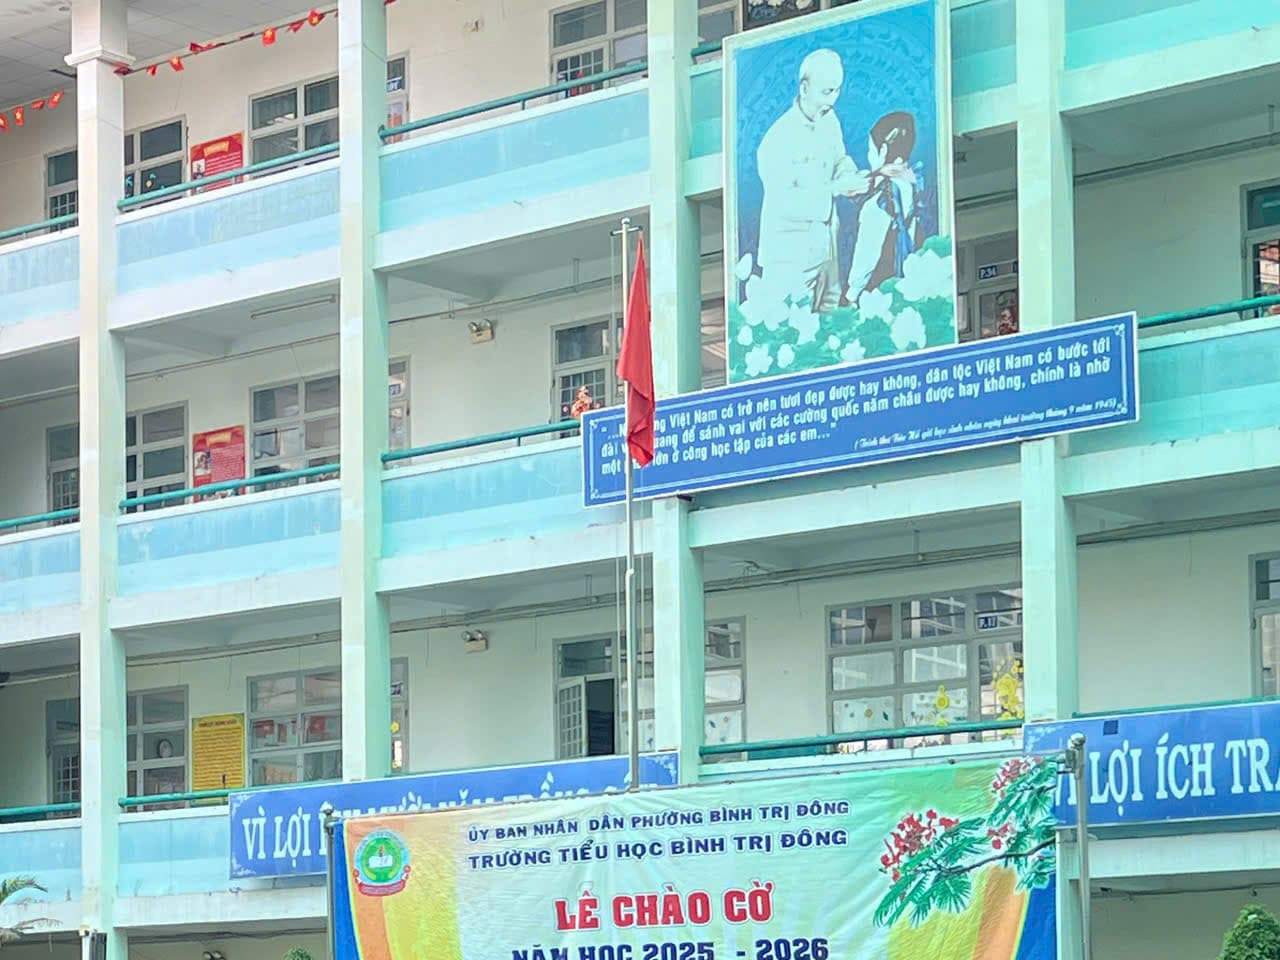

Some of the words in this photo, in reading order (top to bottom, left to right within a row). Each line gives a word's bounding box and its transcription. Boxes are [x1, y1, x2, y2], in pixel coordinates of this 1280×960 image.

[694, 409, 717, 425] Nam
[860, 381, 879, 396] hay
[1005, 353, 1033, 371] Nam
[959, 382, 980, 398] hay
[1089, 739, 1143, 816] LỢI
[1155, 732, 1215, 800] ÍCH
[1225, 738, 1280, 794] TR
[242, 805, 266, 860] VÌ
[273, 806, 311, 868] LỢI
[468, 826, 489, 841] ỦY
[495, 825, 527, 839] BAN
[533, 819, 578, 836] NHÂN
[589, 815, 624, 831] DÂN
[631, 810, 703, 828] PHƯỜNG
[710, 807, 752, 822] BÌNH
[759, 805, 789, 820] TRỊ
[797, 800, 849, 817] ĐÔNG
[468, 849, 551, 869] TRƯỜNG
[559, 839, 608, 862] TIỂU
[617, 842, 663, 859] HỌC
[671, 837, 724, 855] BÌNH
[733, 835, 771, 852] TRỊ
[780, 829, 847, 848] ĐÔNG
[613, 885, 712, 927] CHÀO
[724, 881, 773, 922] CỜ
